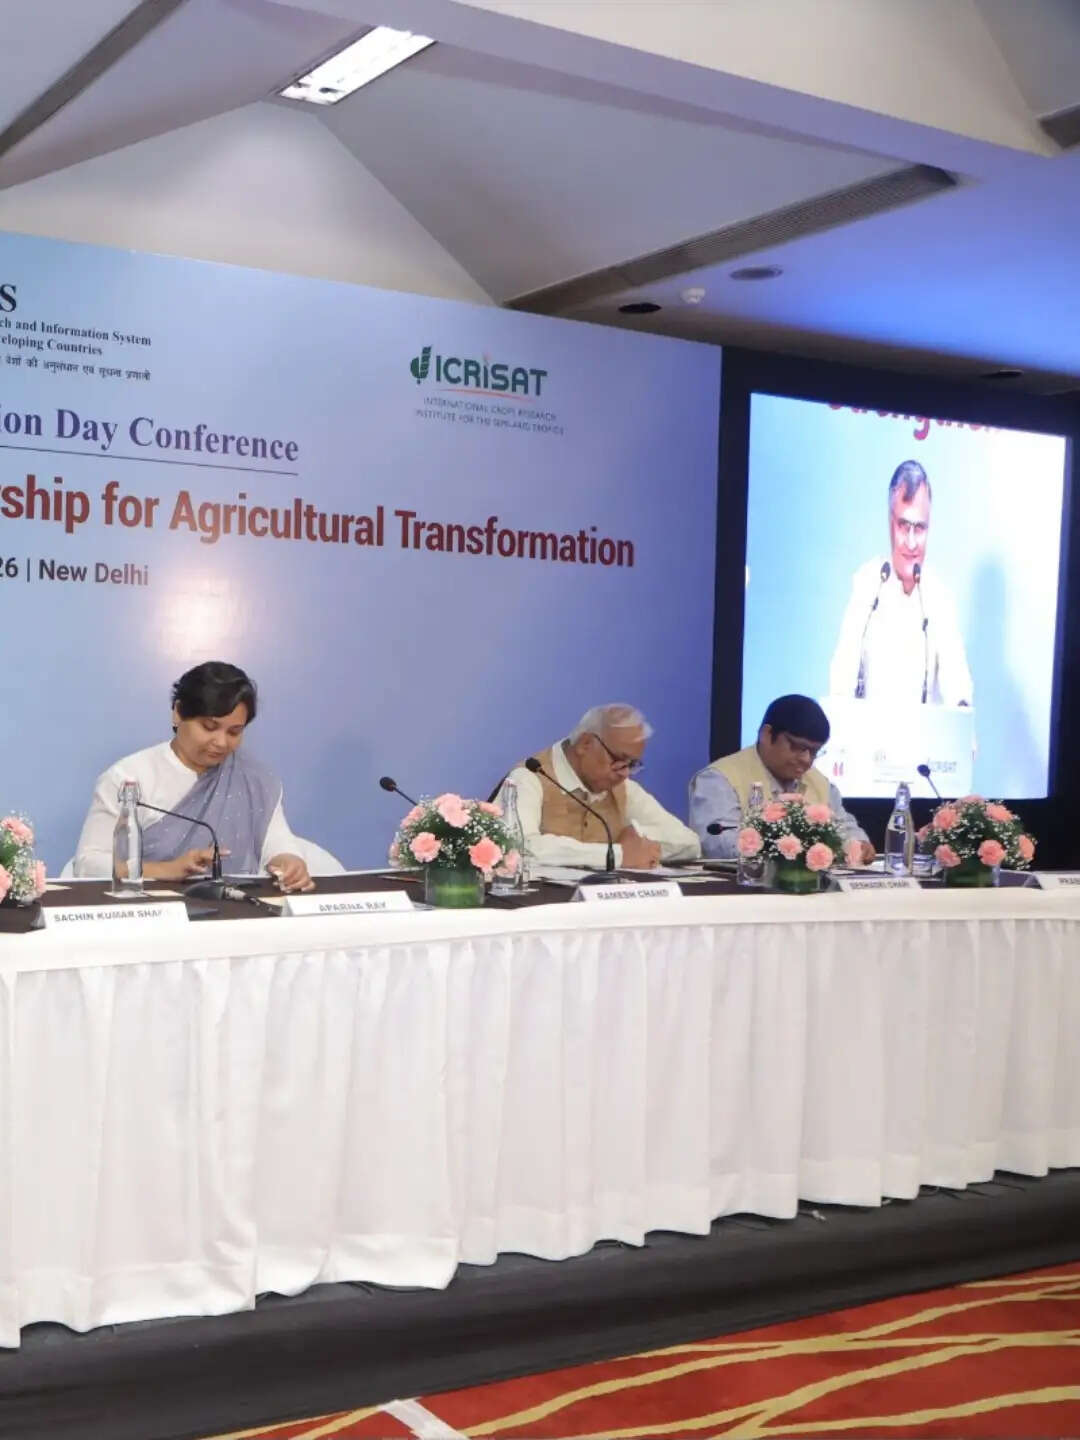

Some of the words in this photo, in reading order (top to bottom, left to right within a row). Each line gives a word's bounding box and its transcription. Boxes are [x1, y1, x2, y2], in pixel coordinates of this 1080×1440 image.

[15, 321, 37, 332] and
[41, 322, 109, 341] Information
[112, 332, 151, 347] System
[47, 338, 102, 355] Countries
[435, 354, 548, 397] ICRISAT
[56, 406, 119, 451] Day
[128, 416, 299, 462] Conference
[101, 480, 159, 528] for
[168, 490, 384, 547] Agricultural
[395, 510, 635, 568] Transformation
[39, 559, 87, 583] New
[95, 562, 149, 586] Delhi
[54, 913, 94, 922] SACHIN
[97, 911, 134, 920] KUMAR
